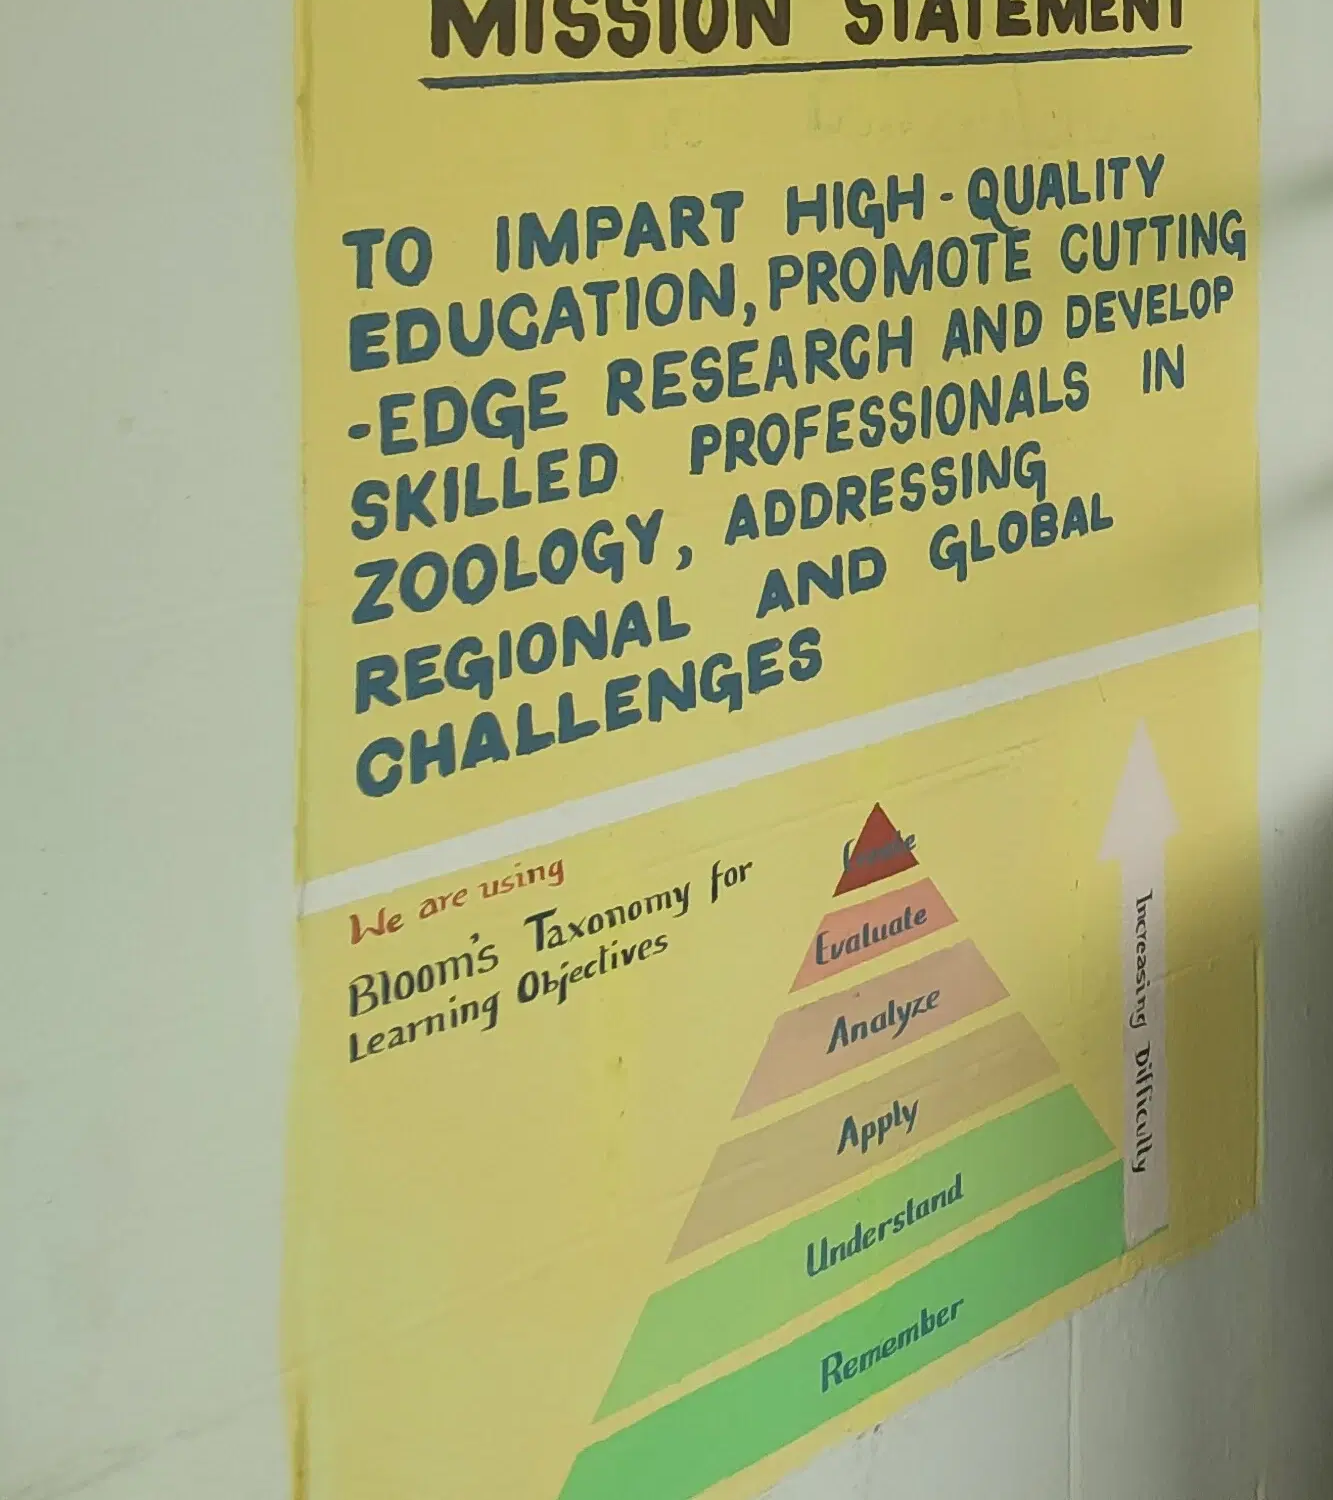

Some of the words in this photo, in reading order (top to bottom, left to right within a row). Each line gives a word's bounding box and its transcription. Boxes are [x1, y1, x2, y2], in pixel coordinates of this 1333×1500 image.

[341, 226, 435, 291] TO
[495, 188, 746, 274] IMPART
[348, 272, 759, 372] EDUCATION,
[768, 226, 1034, 311] PROMOTE
[1059, 208, 1249, 275] CUTTING
[605, 321, 918, 419] RESEARCH
[942, 298, 1043, 364] AND
[1065, 277, 1236, 341] DEVELOP
[350, 441, 621, 542] SKILLED
[690, 360, 1092, 476] PROFESSIONALS
[1141, 344, 1187, 396] IN
[350, 507, 694, 626] ZOOLOGY,
[723, 439, 1048, 546] ADDRESSING
[353, 594, 693, 715] REGIONAL
[756, 545, 889, 621] AND
[927, 491, 1115, 583] GLOBAL
[353, 626, 824, 799] CHALLENGES
[347, 930, 501, 1019] Bloom's
[523, 879, 693, 956] Taxonomy
[708, 855, 756, 907] for
[348, 908, 405, 945] We
[417, 884, 471, 916] are
[478, 853, 567, 904] using
[814, 902, 930, 967] Evaluate
[1126, 889, 1155, 1031] Increasing
[347, 988, 501, 1065] Learning
[515, 928, 671, 1006] Objectives
[824, 983, 942, 1055] Analyze
[835, 1097, 921, 1157] Apply
[805, 1172, 965, 1279] Understand
[820, 1294, 967, 1395] Remember
